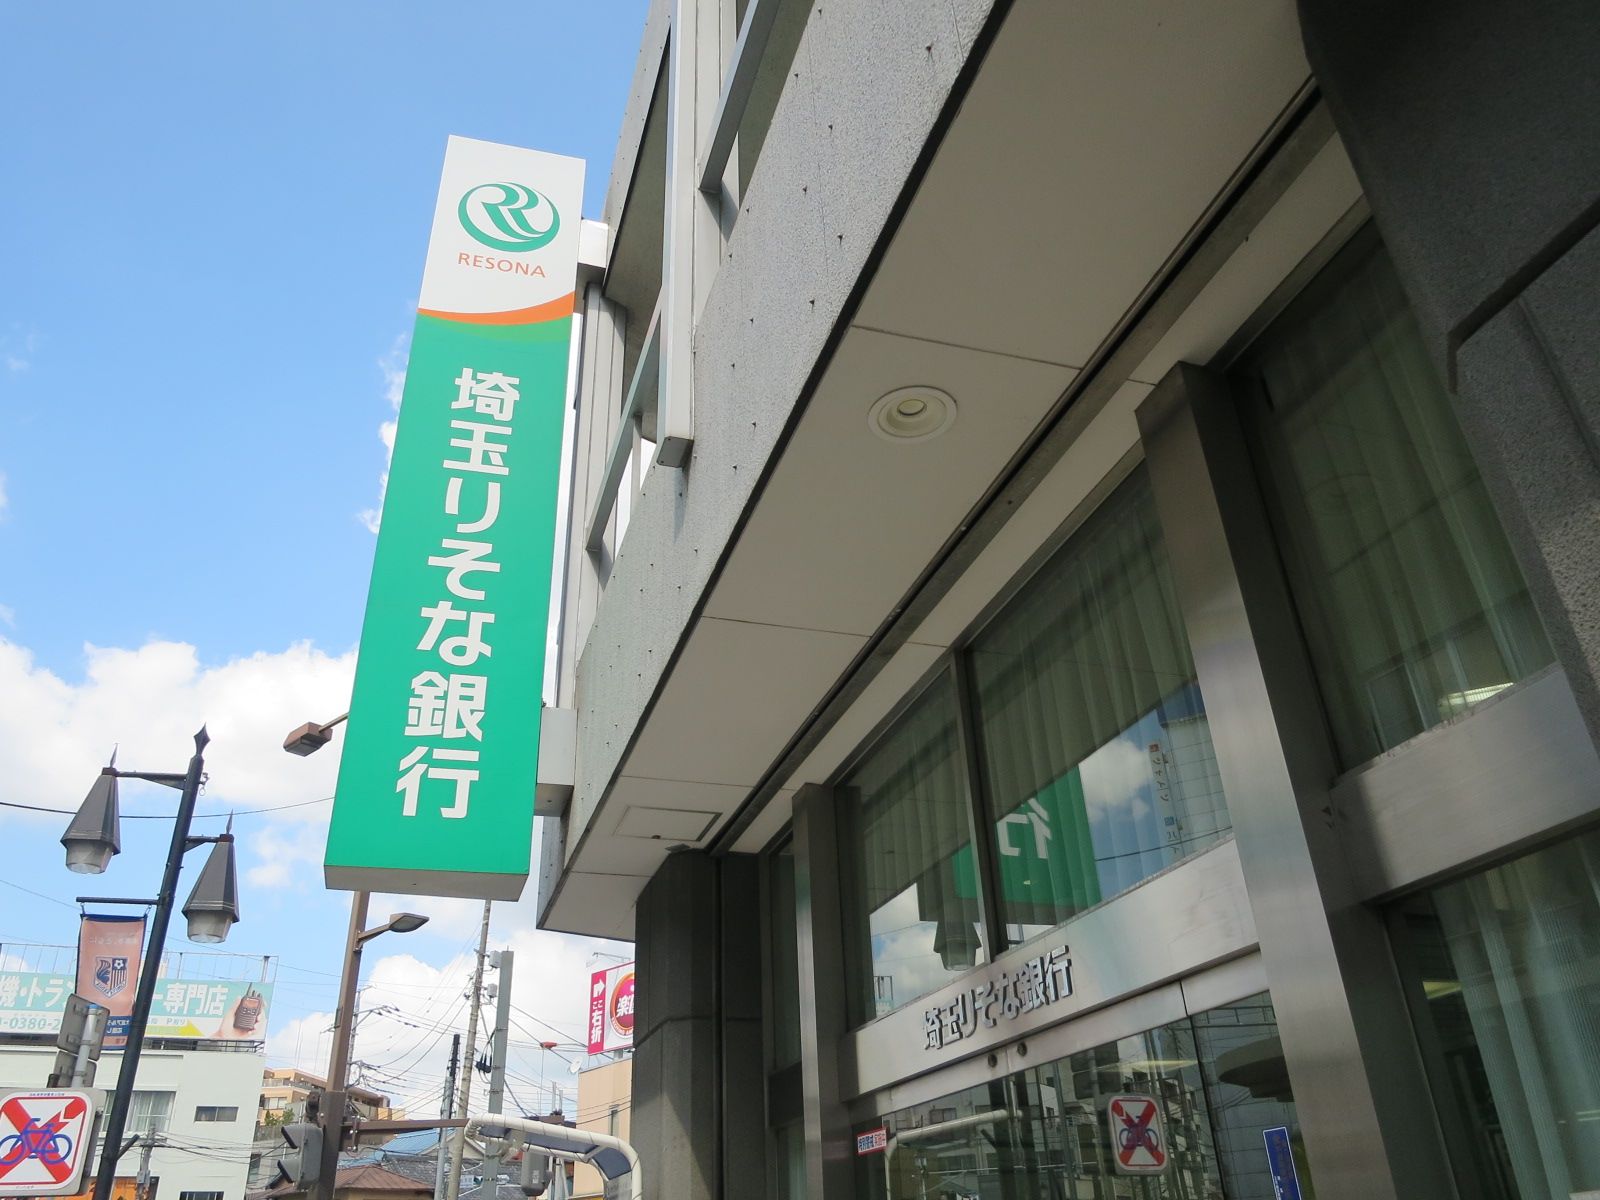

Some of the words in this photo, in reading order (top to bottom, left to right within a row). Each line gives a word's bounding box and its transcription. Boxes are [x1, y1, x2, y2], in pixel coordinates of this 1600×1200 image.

[457, 252, 547, 278] RESONA
[394, 366, 521, 820] 埼玉りそな銀行
[590, 1000, 603, 1044] ここ右折
[922, 945, 1074, 1051] 埼玉りそな銀行
